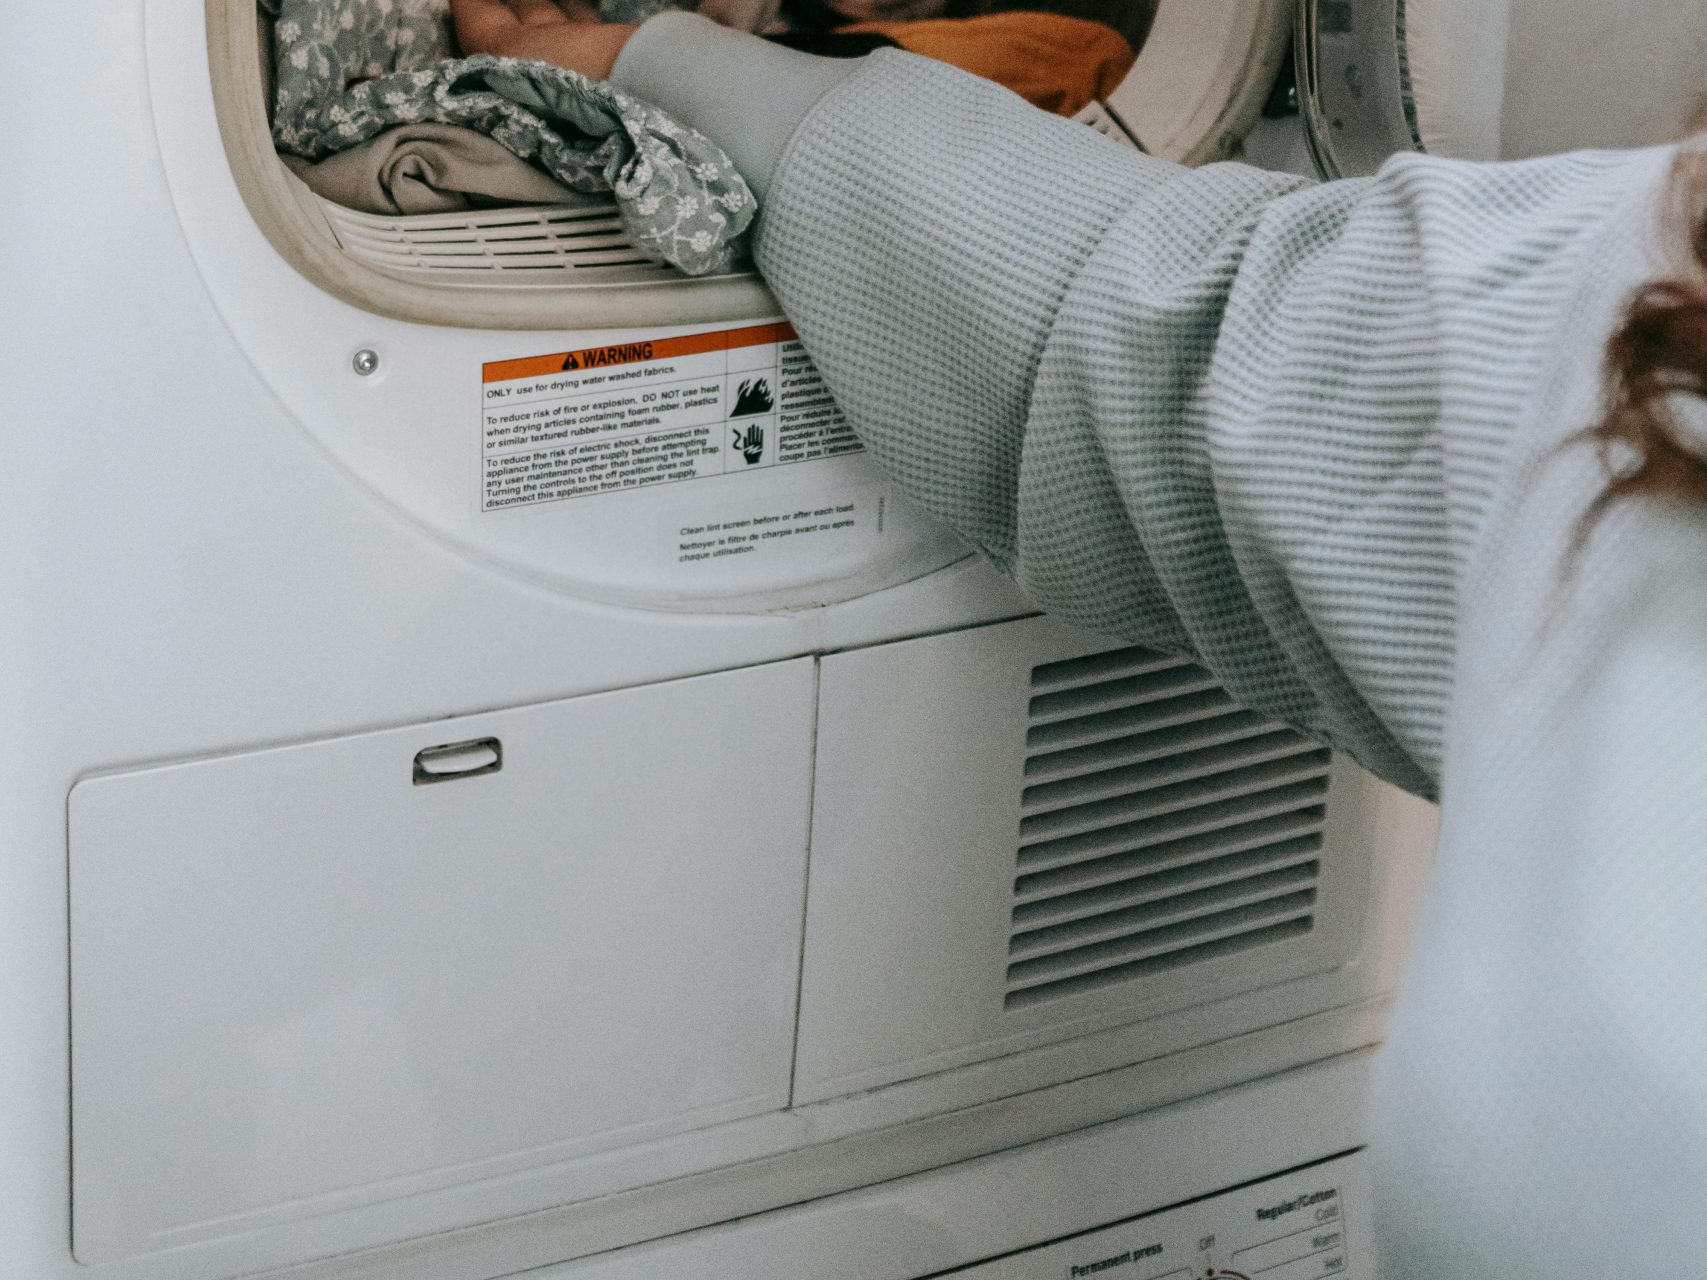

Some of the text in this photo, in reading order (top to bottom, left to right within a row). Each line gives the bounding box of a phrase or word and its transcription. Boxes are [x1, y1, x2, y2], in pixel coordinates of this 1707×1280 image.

[582, 342, 654, 368] WARNING
[486, 388, 512, 399] ONLY
[517, 386, 533, 395] use
[535, 384, 548, 392] for
[550, 379, 579, 391] drying
[582, 375, 606, 385] water
[608, 368, 642, 381] washed
[486, 427, 511, 437] when
[513, 423, 542, 434] drying
[544, 417, 577, 428] articles
[578, 410, 625, 424] containing
[628, 407, 650, 417] foam
[684, 396, 719, 410] plastics
[487, 417, 497, 425] To
[500, 412, 531, 423] reduce
[533, 409, 550, 418] risk
[552, 406, 562, 416] of
[563, 405, 578, 414] fire
[580, 403, 590, 411] or
[642, 393, 657, 403] DO
[661, 389, 680, 400] NOT
[682, 388, 698, 397] use
[700, 384, 720, 394] heat
[486, 441, 496, 449] or
[498, 436, 528, 447] similar
[531, 429, 568, 442] textured
[570, 423, 617, 437] rubber-like
[487, 459, 498, 467] To
[500, 454, 531, 465] reduce
[533, 452, 547, 460] the
[549, 448, 566, 457] risk
[568, 446, 578, 455] of
[580, 442, 611, 454] electric
[644, 429, 692, 444] disconnect
[693, 427, 710, 436] this
[486, 438, 707, 478] appliance from the power supply before attempting
[486, 480, 502, 488] any
[504, 476, 525, 485] user
[526, 467, 583, 481] maintenance
[585, 463, 608, 473] other
[610, 459, 630, 468] than
[632, 453, 668, 466] cleaning
[670, 451, 684, 460] the
[686, 448, 700, 457] lint
[486, 494, 535, 508] disconnect
[537, 490, 554, 499] this
[556, 483, 599, 497] appliance
[600, 481, 621, 490] from
[623, 478, 637, 487] the
[638, 474, 665, 486] power
[487, 486, 521, 498] Turning
[523, 483, 537, 492] the
[539, 477, 576, 489] controls
[589, 472, 603, 481] the
[605, 470, 617, 480] off
[619, 465, 654, 478] position
[656, 462, 677, 472] does
[679, 459, 694, 467] not
[680, 527, 705, 535] Clean
[707, 523, 720, 532] lint
[722, 520, 751, 529] screen
[753, 516, 780, 525] before
[782, 513, 791, 521] or
[793, 511, 812, 519] after
[814, 507, 834, 516] each
[1071, 1242, 1164, 1278] Permanent press
